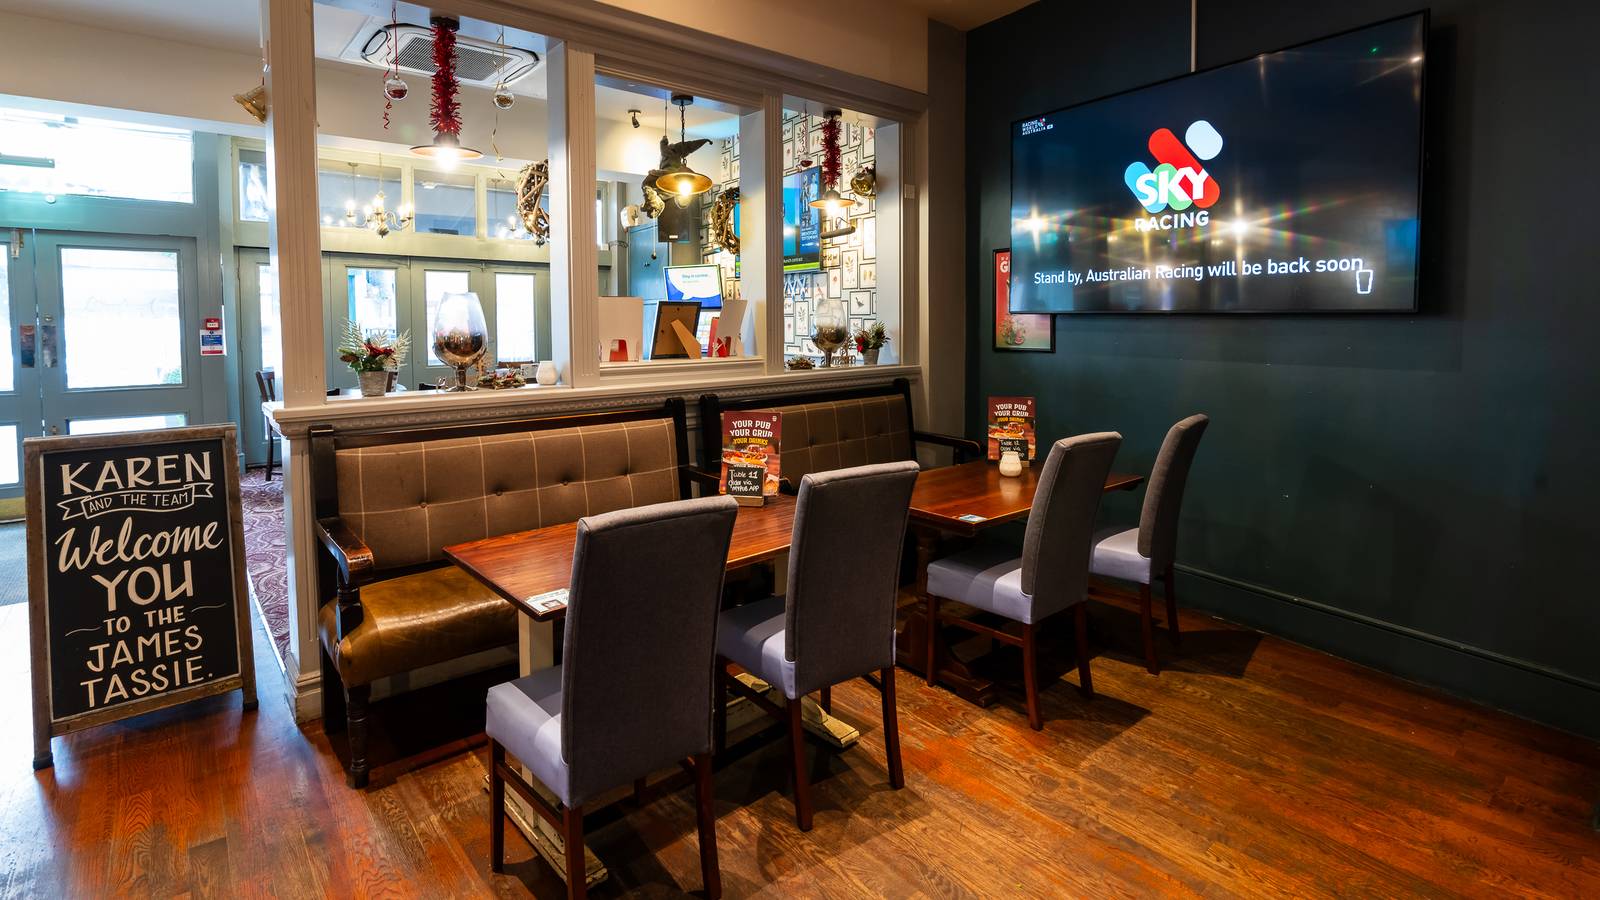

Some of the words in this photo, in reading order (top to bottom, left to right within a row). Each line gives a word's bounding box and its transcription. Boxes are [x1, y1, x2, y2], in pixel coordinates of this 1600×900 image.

[1022, 126, 1046, 135] AUSTRALIA
[1136, 166, 1209, 204] SKY
[1134, 210, 1209, 232] RACING
[1034, 271, 1064, 284] Stand
[1068, 270, 1083, 286] by,
[1086, 266, 1150, 282] Australian
[1155, 264, 1203, 281] Racing
[1208, 261, 1237, 276] will
[1241, 260, 1262, 275] be
[1267, 257, 1310, 274] back
[1315, 257, 1363, 273] soon
[1014, 403, 1027, 411] PUB
[729, 429, 750, 437] YOUR
[752, 429, 773, 438] GRUB
[732, 420, 753, 429] YOUR
[755, 420, 771, 430] PUB
[748, 438, 768, 446] DRINKS
[60, 451, 212, 495] KAREN
[729, 469, 746, 480] Table
[89, 497, 113, 513] AND
[120, 494, 147, 505] THE
[153, 492, 189, 507] TEAM
[55, 516, 223, 573] Welcome
[91, 560, 193, 612] YOU
[104, 615, 131, 636] TO
[144, 606, 186, 626] THE
[86, 625, 203, 672] JAMES
[80, 656, 213, 708] TASSIE.
